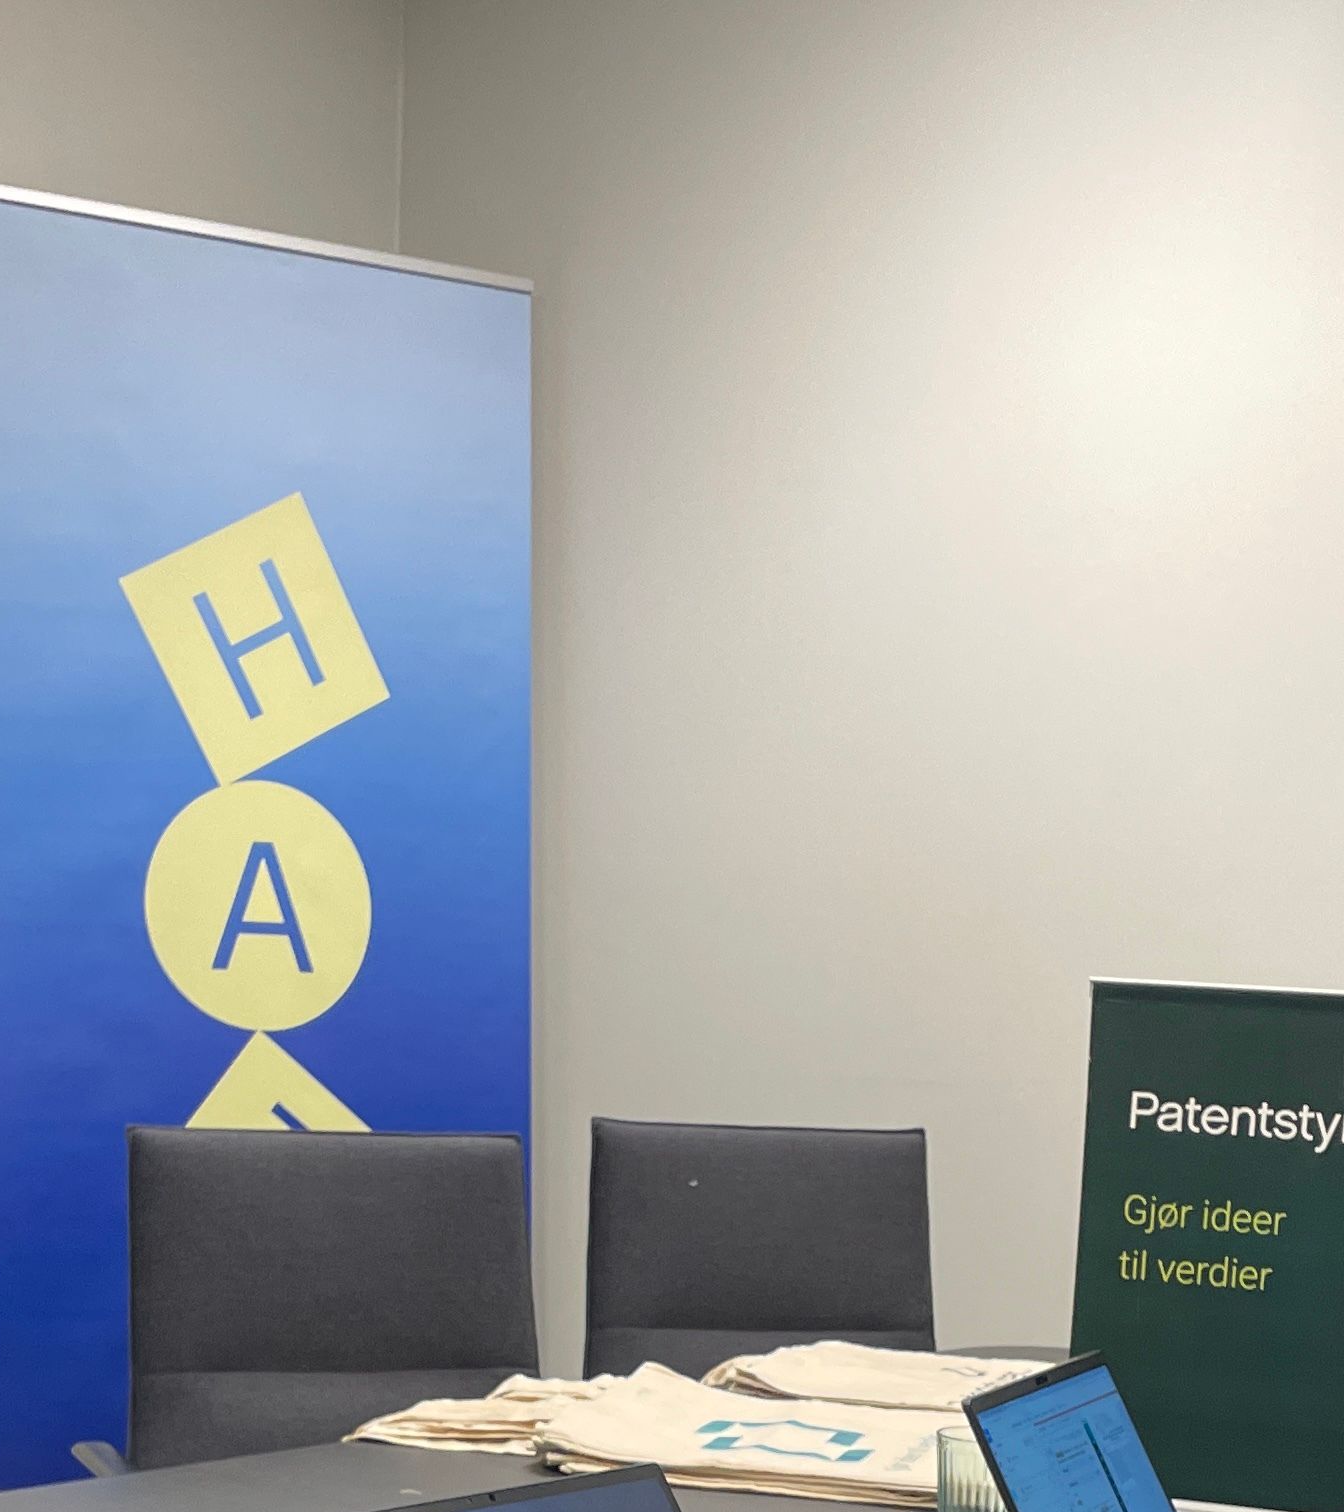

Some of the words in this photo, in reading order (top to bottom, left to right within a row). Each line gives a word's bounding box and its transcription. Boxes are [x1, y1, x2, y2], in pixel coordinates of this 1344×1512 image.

[1122, 1193, 1193, 1235] Gjør
[1202, 1199, 1289, 1236] ideer
[1118, 1249, 1147, 1281] til
[1157, 1255, 1274, 1291] verdier
